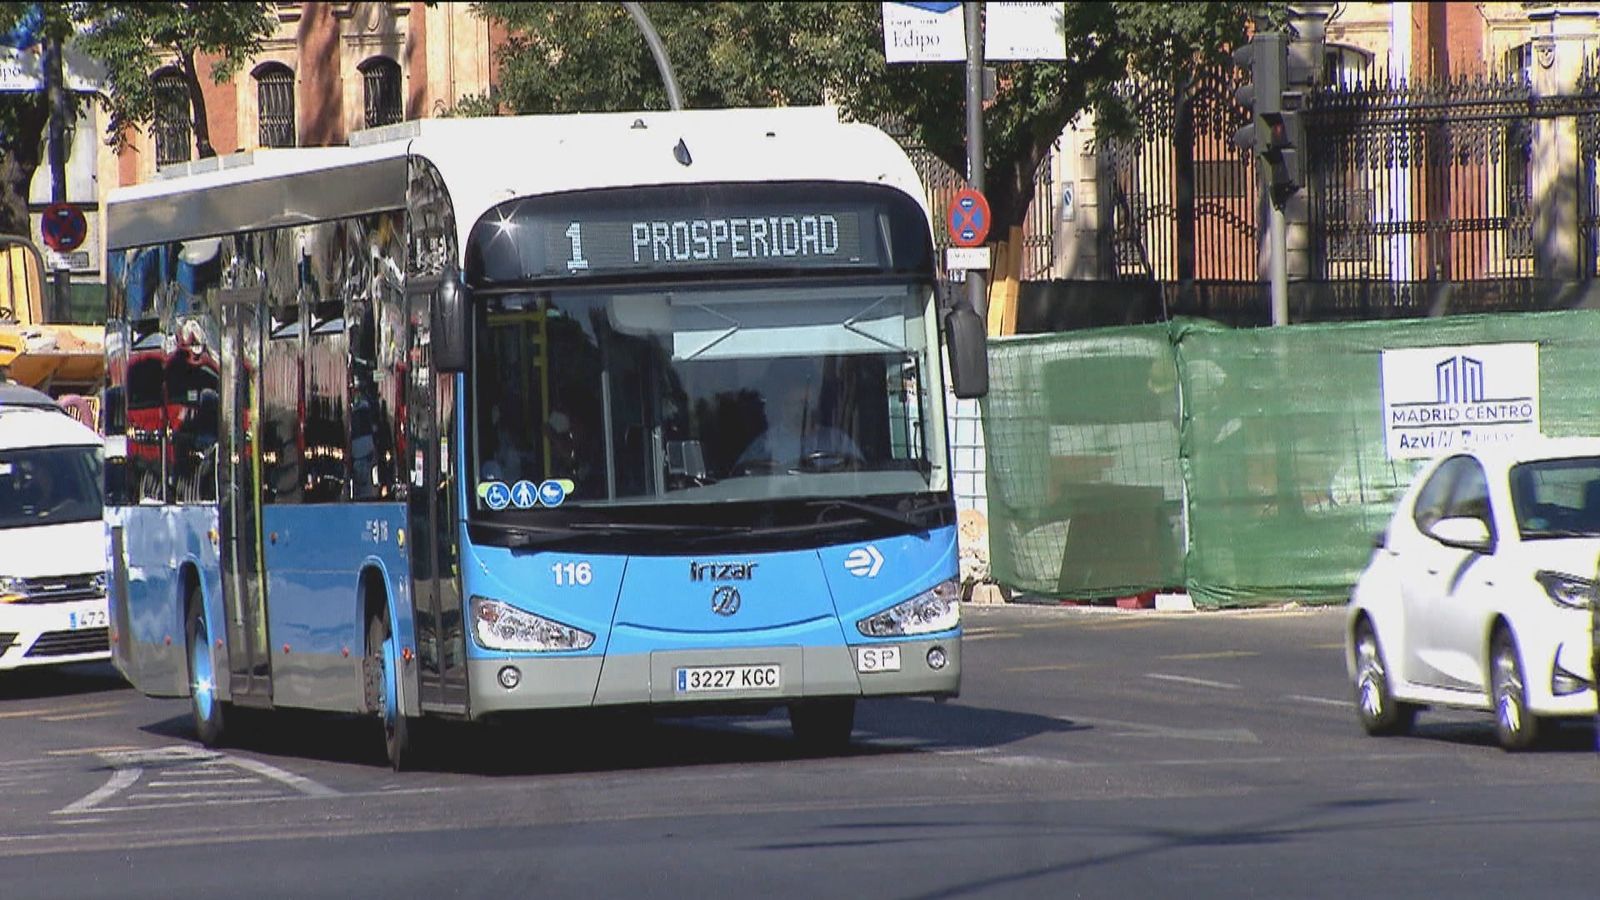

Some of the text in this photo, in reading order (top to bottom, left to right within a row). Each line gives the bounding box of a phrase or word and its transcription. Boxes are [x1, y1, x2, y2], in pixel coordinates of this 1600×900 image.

[565, 215, 839, 270] 1 PROSPERIDAD
[1392, 403, 1533, 423] MADRID CENTRO
[551, 561, 593, 586] 116
[690, 668, 776, 688] 3227 KGC
